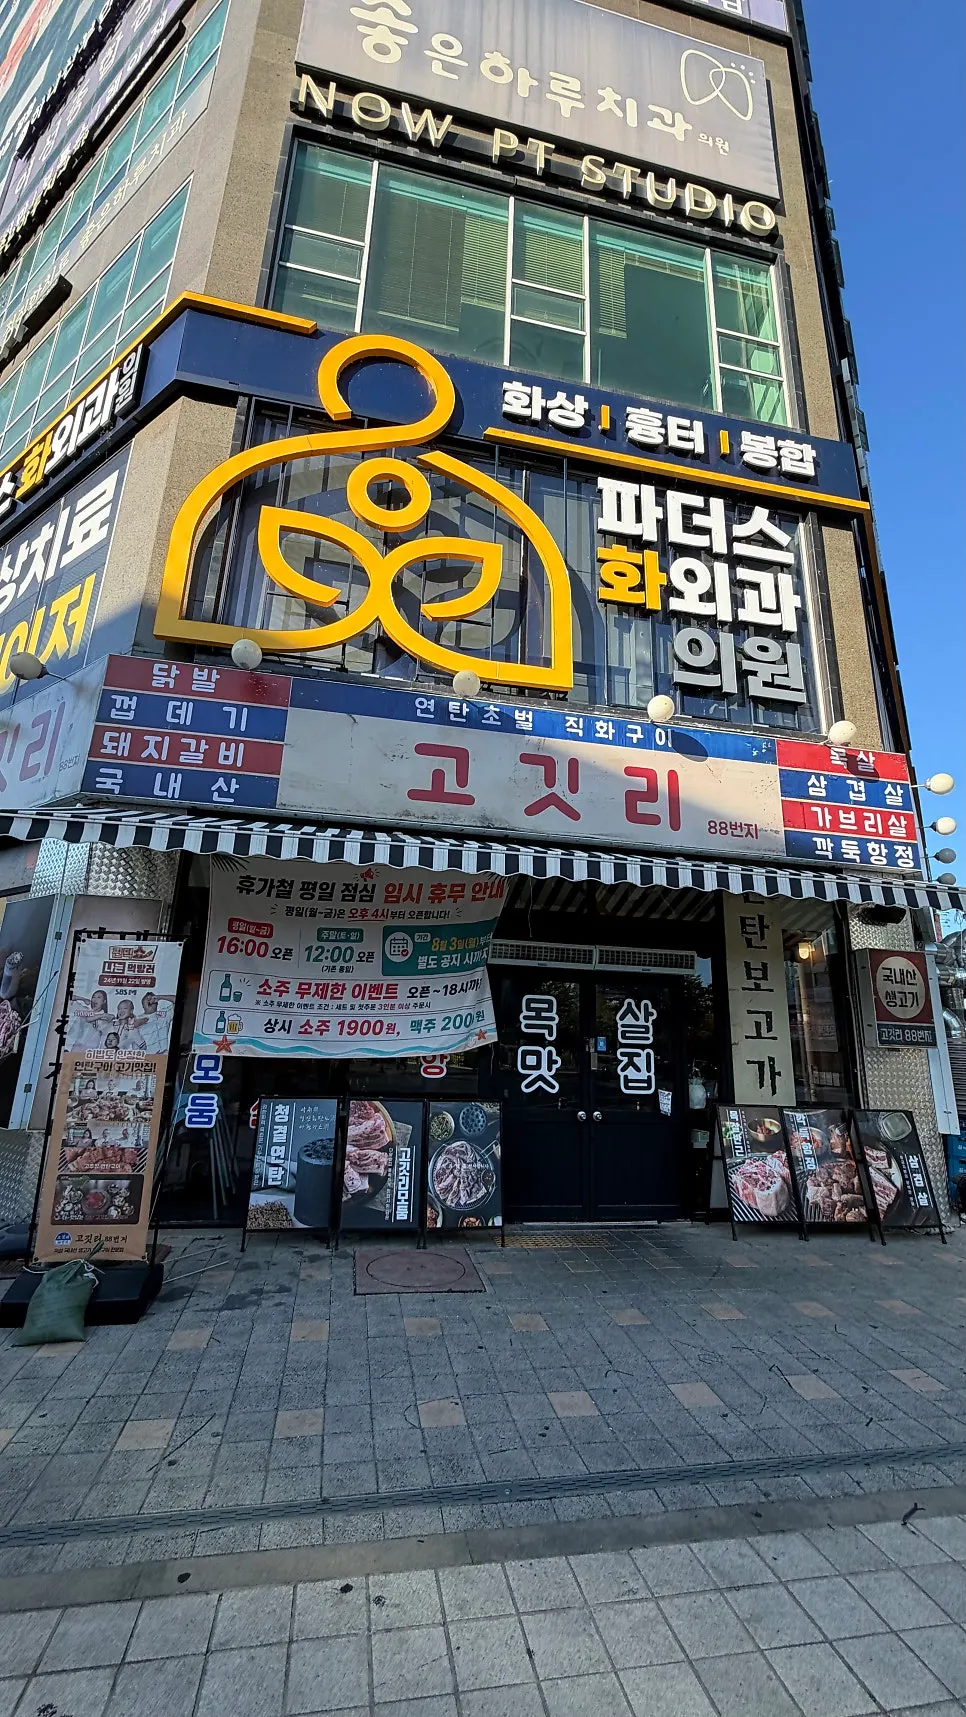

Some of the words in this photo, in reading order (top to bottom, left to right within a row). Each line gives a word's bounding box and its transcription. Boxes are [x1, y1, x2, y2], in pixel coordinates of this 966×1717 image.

[349, 0, 693, 142] 좋은하루치과
[697, 132, 731, 157] 의원
[298, 73, 453, 147] NOW
[492, 129, 556, 176] PT
[581, 155, 777, 236] STUDIO
[502, 381, 589, 430] 화상
[625, 406, 705, 455] 흉터
[740, 430, 817, 477] 봉합
[597, 476, 795, 567] 파더스
[597, 544, 802, 634] 화외과
[151, 663, 221, 694] 닭발
[673, 627, 807, 704] 의원
[110, 694, 249, 732] 껍데기
[414, 696, 534, 732] 연탄초벌
[564, 714, 672, 748] 직화구이
[100, 731, 245, 768] 돼지갈비
[829, 747, 876, 773] 목살
[95, 767, 240, 803] 국내산
[407, 742, 682, 832] 고깃리
[707, 819, 760, 840] 88번지
[807, 774, 904, 806] 삼겹살
[810, 806, 908, 838] 가브리살
[812, 836, 916, 869] 깍둑항정
[236, 874, 295, 901] 휴가철
[299, 880, 335, 901] 평일
[340, 882, 376, 903] 점심
[384, 882, 424, 905] 임시
[427, 882, 467, 904] 휴무
[471, 880, 505, 901] 안내
[348, 907, 369, 920] 오후
[371, 908, 405, 920] 4시부터
[407, 908, 450, 920] 오픈합니다!
[217, 935, 270, 958] 16:00
[270, 947, 294, 961] 오픈
[304, 945, 355, 964] 12:00
[356, 951, 376, 963] 오픈
[431, 938, 447, 952] 8월
[417, 955, 438, 970] 별도
[440, 953, 461, 968] 공지
[881, 966, 917, 987] 국내산
[256, 978, 291, 998] 소주
[295, 981, 347, 1000] 무제한
[351, 982, 399, 1001] 이벤트
[264, 1018, 293, 1034] 상시
[298, 1018, 331, 1036] 소주
[410, 1018, 437, 1034] 맥주
[880, 1028, 903, 1042] 고깃리
[904, 1028, 932, 1042] 88번지
[115, 1061, 157, 1073] 고기맛집!
